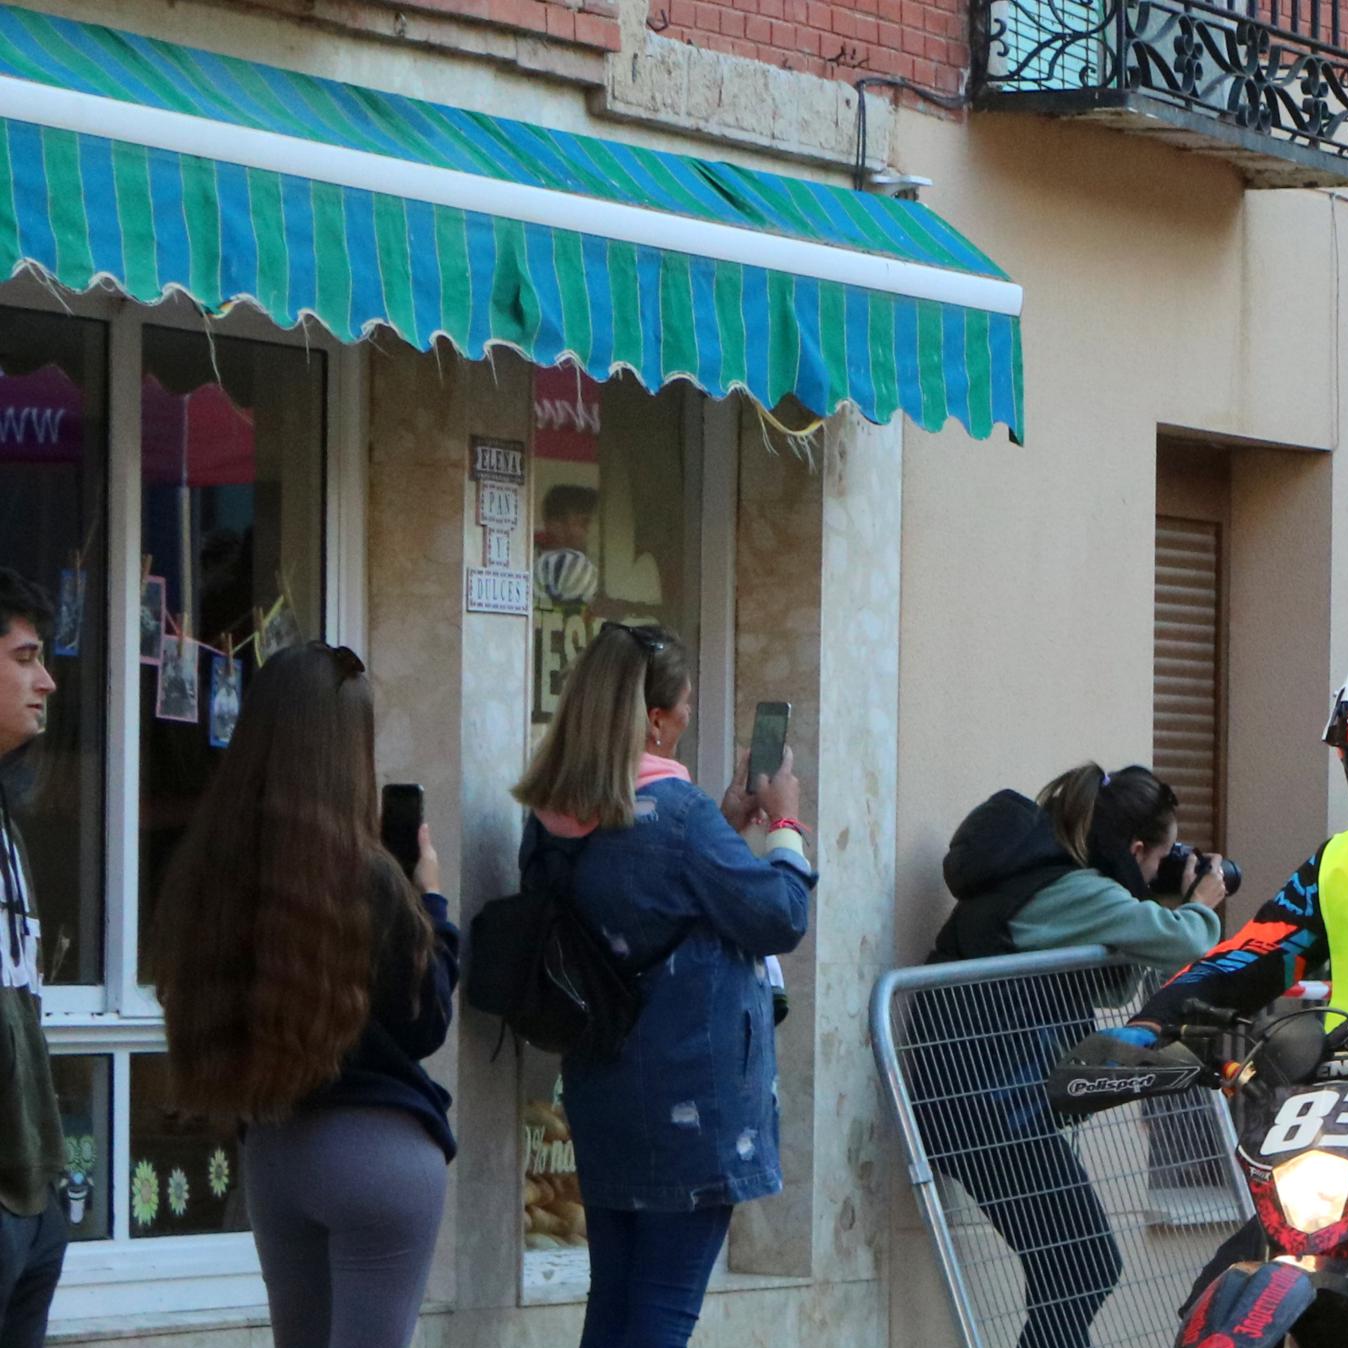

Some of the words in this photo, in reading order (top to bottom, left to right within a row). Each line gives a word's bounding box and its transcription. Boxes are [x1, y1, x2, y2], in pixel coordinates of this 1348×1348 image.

[480, 449, 521, 476] ELENA
[488, 490, 512, 512] PAN
[476, 578, 522, 603] DULCES
